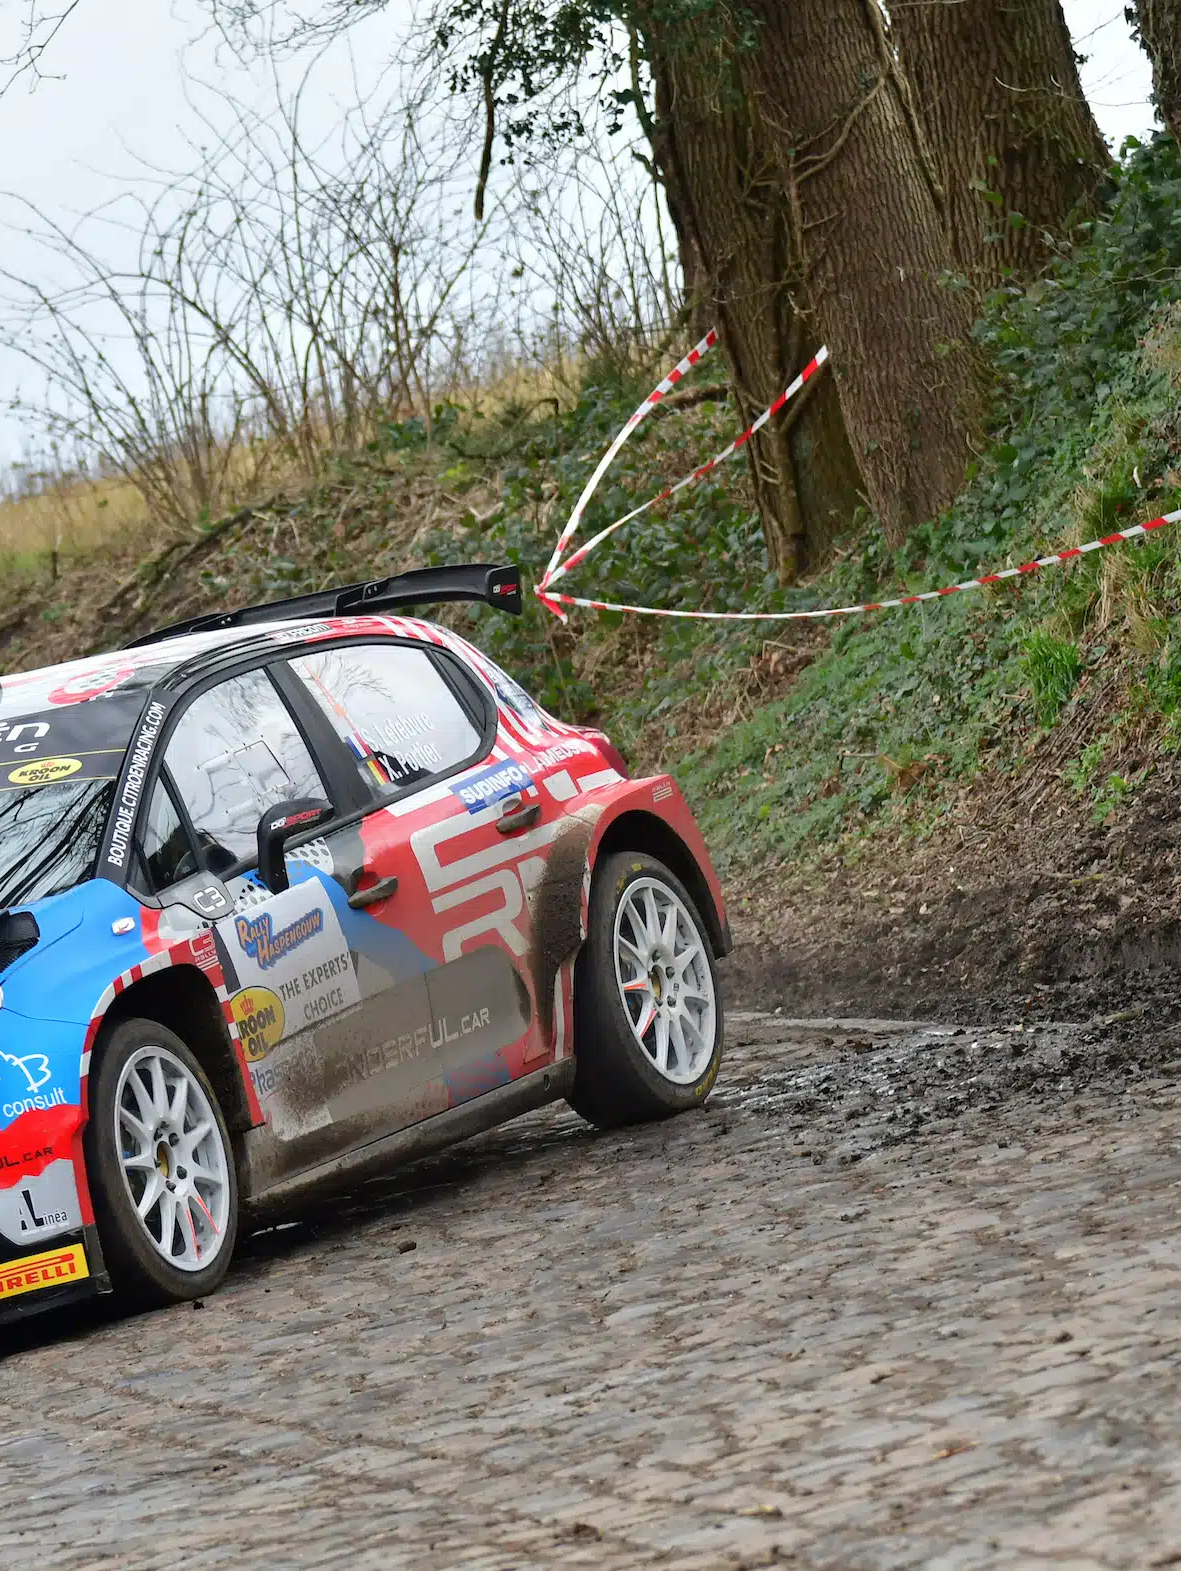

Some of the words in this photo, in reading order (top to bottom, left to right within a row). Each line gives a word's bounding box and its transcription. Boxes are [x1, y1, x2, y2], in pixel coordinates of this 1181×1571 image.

[19, 765, 71, 777] KROON
[107, 701, 166, 868] BOUTIQUE.CITROENRACING.COM
[236, 916, 271, 947] RALLY
[257, 910, 321, 966] HASPENGOUW
[279, 978, 301, 1002] THE
[303, 987, 344, 1020] CHOICE
[236, 1003, 277, 1041] ROON
[248, 1031, 270, 1056] OIL
[2, 1087, 67, 1117] consult
